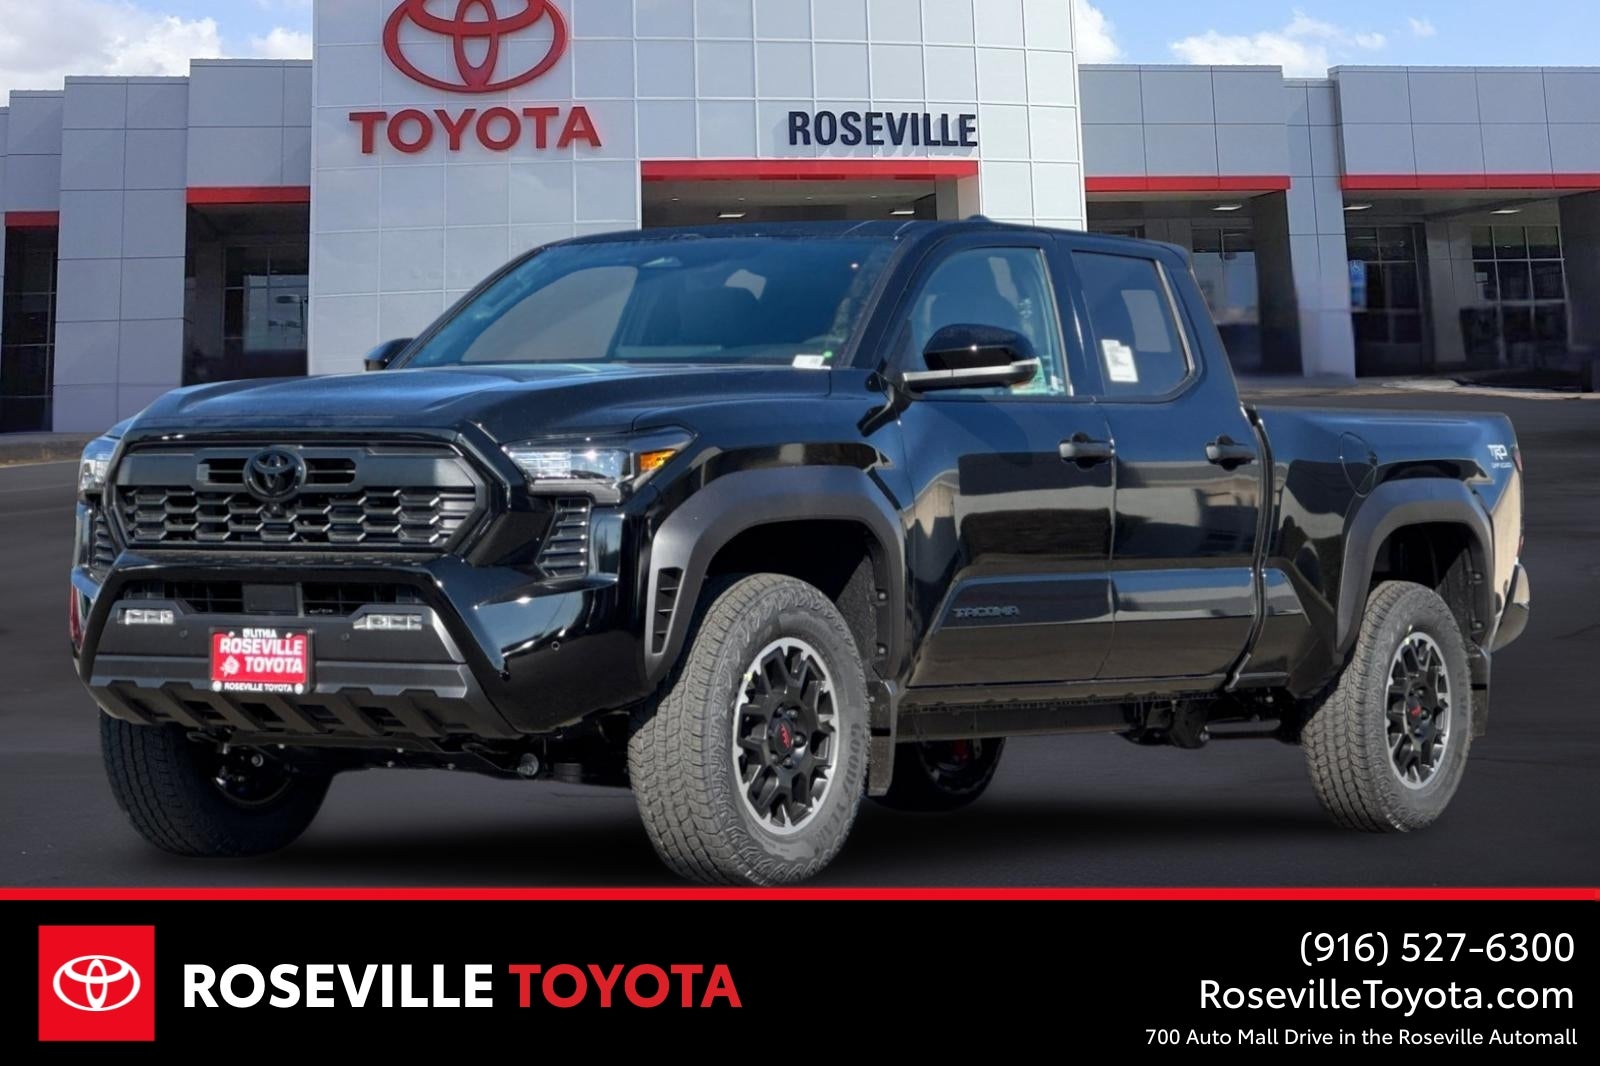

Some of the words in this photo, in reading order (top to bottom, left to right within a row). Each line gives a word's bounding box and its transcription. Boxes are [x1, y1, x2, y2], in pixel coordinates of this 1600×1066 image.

[349, 106, 602, 154] TOYOTA
[788, 110, 978, 148] ROSEVILLE
[952, 605, 1020, 618] TACOMA
[220, 638, 303, 655] ROSEVILLE
[244, 656, 303, 673] TOYOTA
[224, 682, 263, 692] ROSEVILLE
[264, 683, 294, 693] TOYOTA
